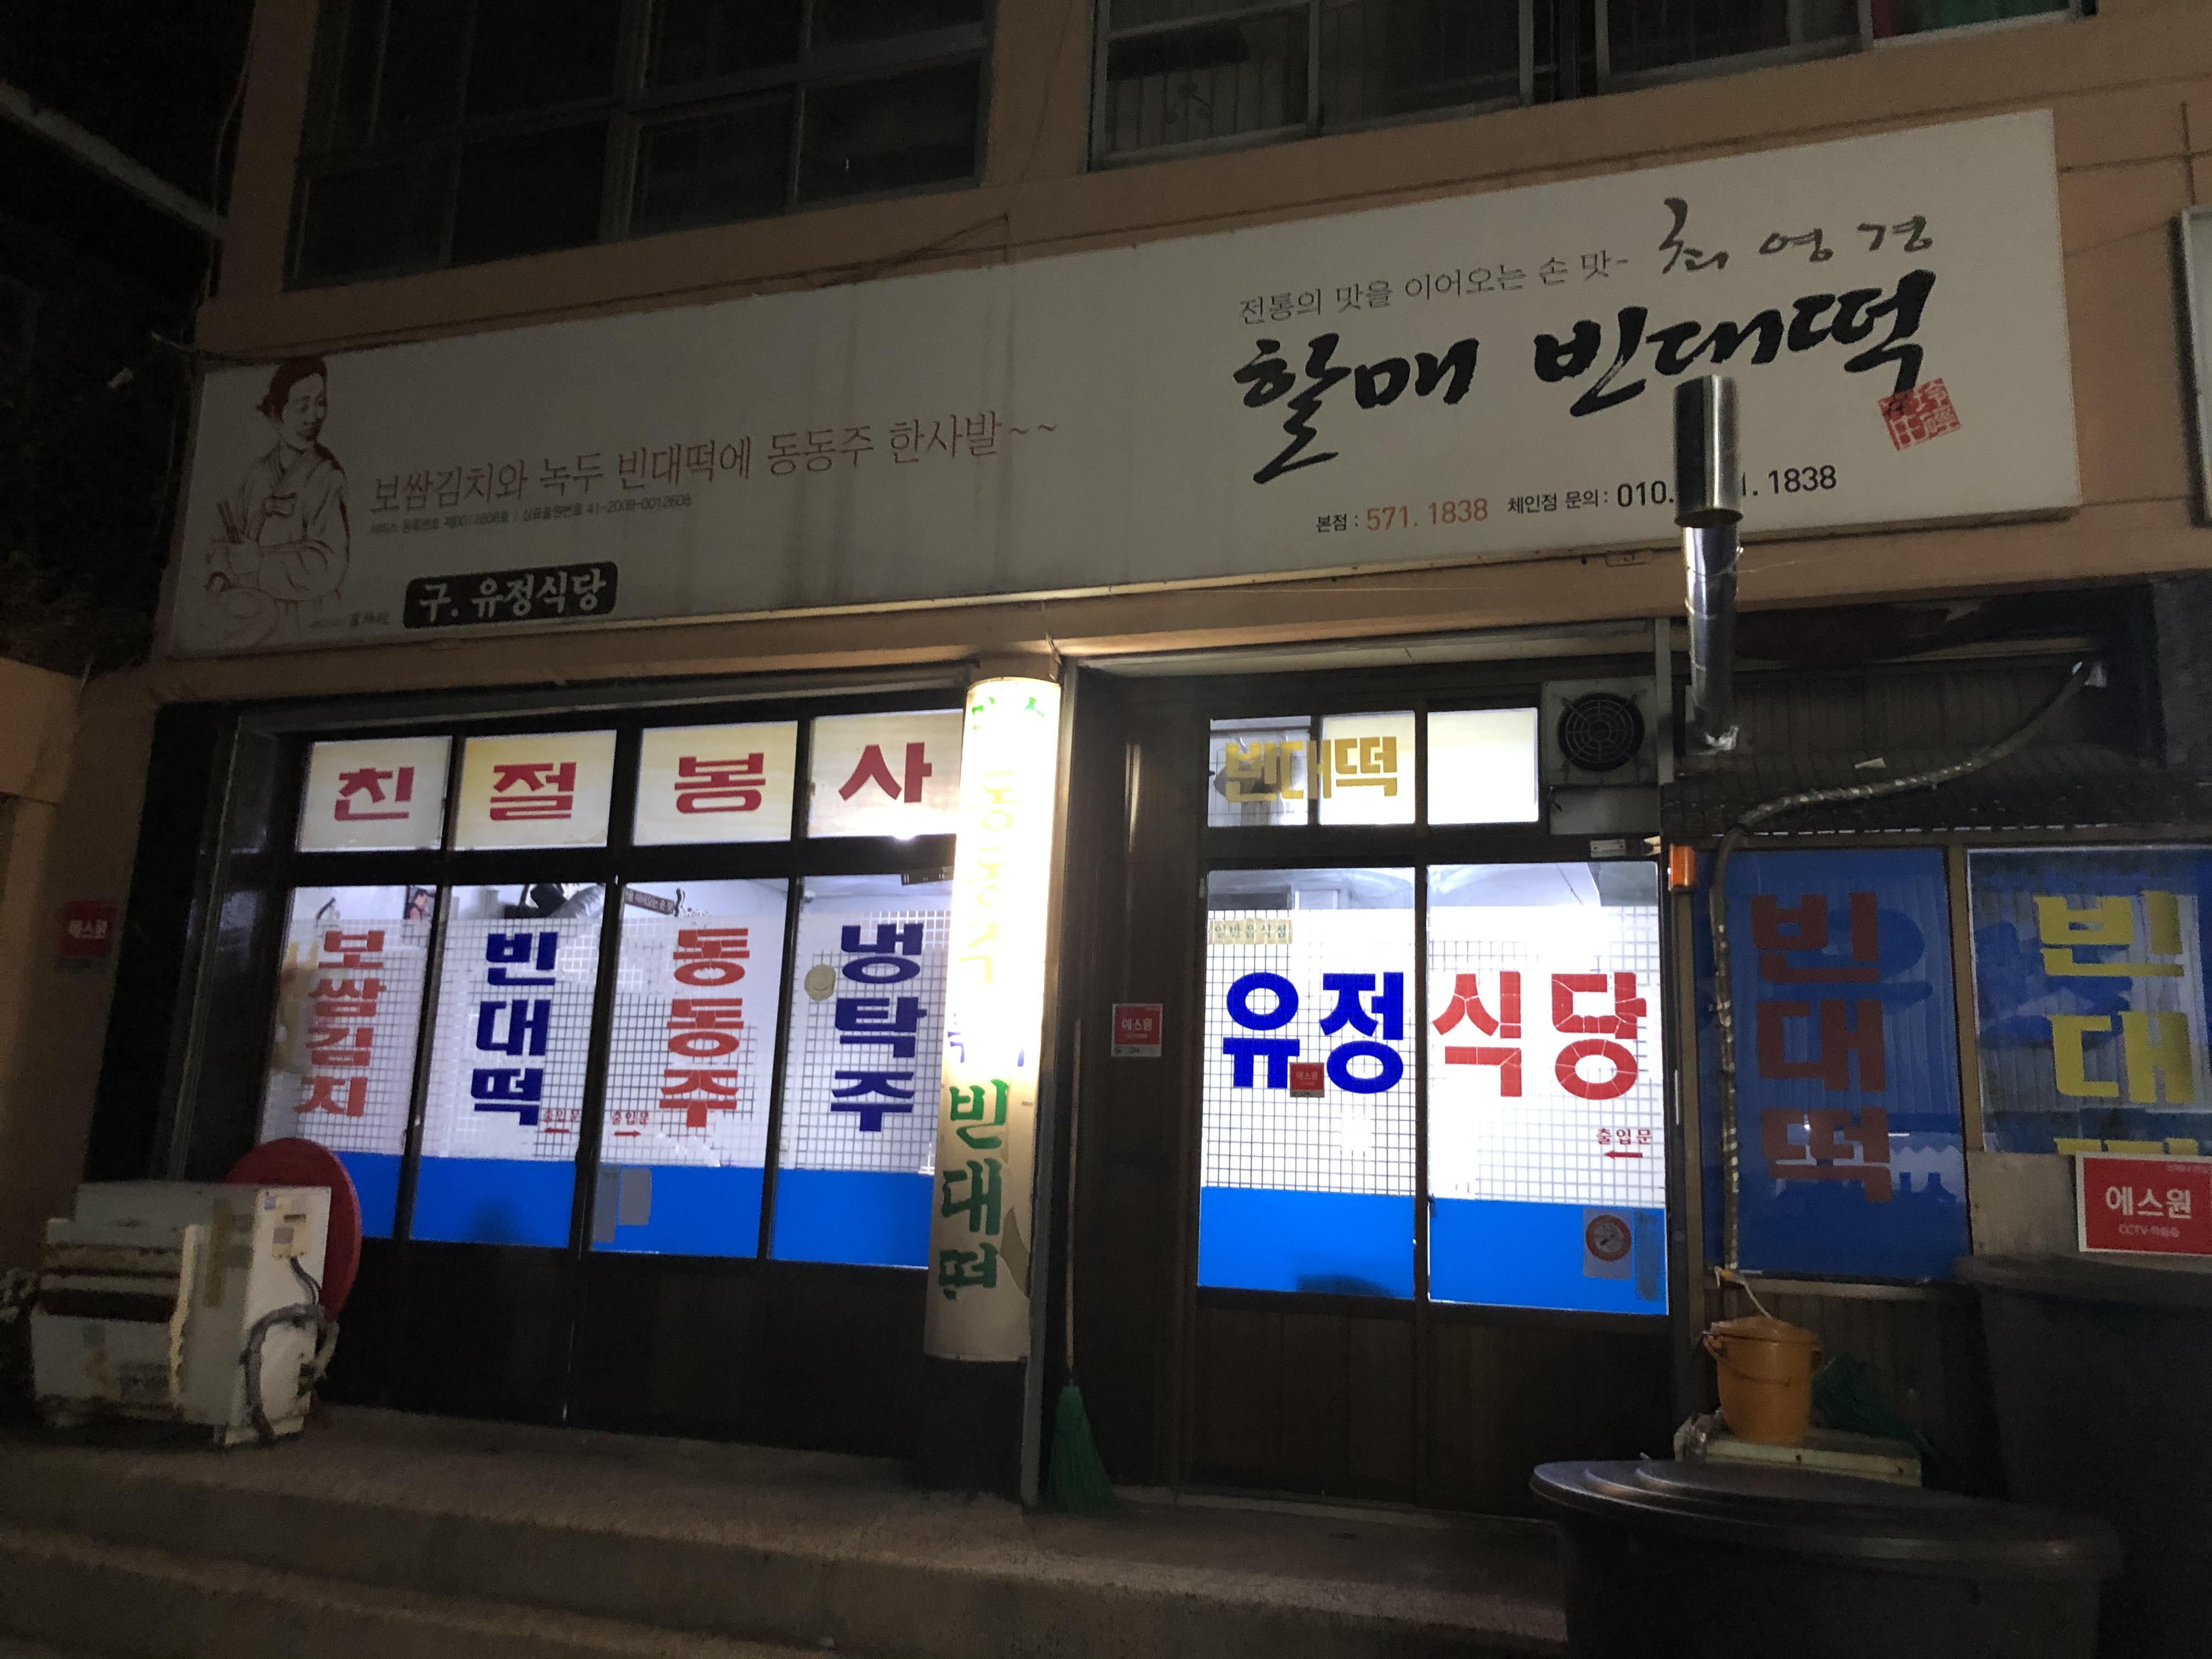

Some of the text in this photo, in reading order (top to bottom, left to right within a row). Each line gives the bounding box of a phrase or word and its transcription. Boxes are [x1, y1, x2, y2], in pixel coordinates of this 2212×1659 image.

[1239, 288, 1322, 325] 전통의
[1335, 280, 1393, 314] 맛을
[1405, 264, 1527, 301] 이어오는
[1537, 257, 1568, 285] 손
[1232, 332, 1479, 483] 할매
[1534, 269, 1936, 417] 빈대떡
[370, 458, 529, 515] 보쌈김치와
[540, 452, 603, 497] 녹두
[618, 435, 751, 491] 빈대떡에
[767, 425, 875, 477] 동동주
[1366, 505, 1418, 532] 571.
[1427, 498, 1488, 525] 1838
[1508, 493, 1558, 515] 체인점
[1617, 480, 1674, 507] 010.
[1768, 465, 1837, 494] 1838
[419, 567, 607, 624] 구. 유정식당
[1225, 736, 1398, 803] 빈대떡
[292, 930, 387, 1118] 보쌈김치
[471, 931, 559, 1126] 빈대떡
[659, 927, 750, 1128] 동동주
[830, 923, 927, 1132] 냉탁주
[1751, 891, 1893, 1202] 빈대떡
[2033, 889, 2199, 1155] 빈대
[1596, 1127, 1654, 1146] 출입문
[2105, 1185, 2192, 1219] 에스원
